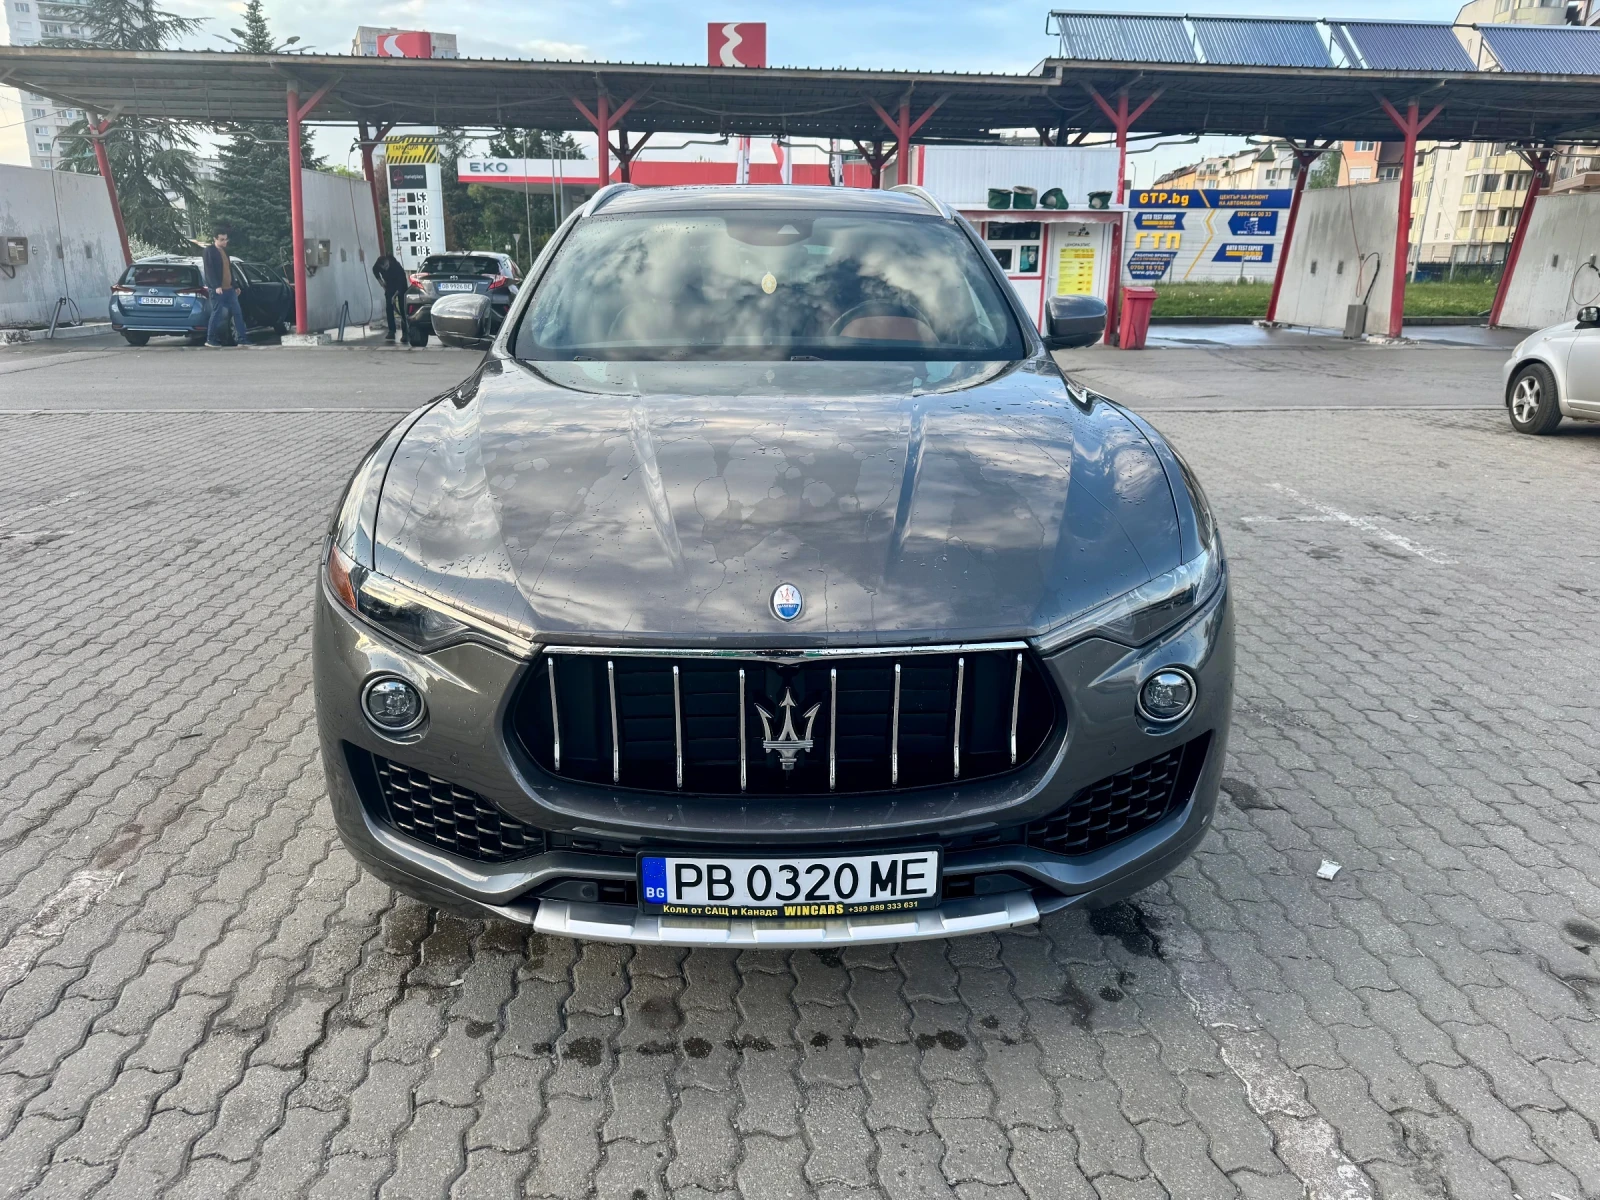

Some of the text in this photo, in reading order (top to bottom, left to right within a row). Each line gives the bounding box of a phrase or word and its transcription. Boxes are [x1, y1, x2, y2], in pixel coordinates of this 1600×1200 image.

[469, 162, 508, 173] EKO
[1139, 192, 1190, 207] GTP.bg
[1134, 232, 1181, 249] ГТП
[674, 857, 929, 901] PB 0320 ME
[646, 886, 665, 899] BG
[663, 901, 919, 917] Коли от САЩ и Канада WINCARS +359 889 333 631
